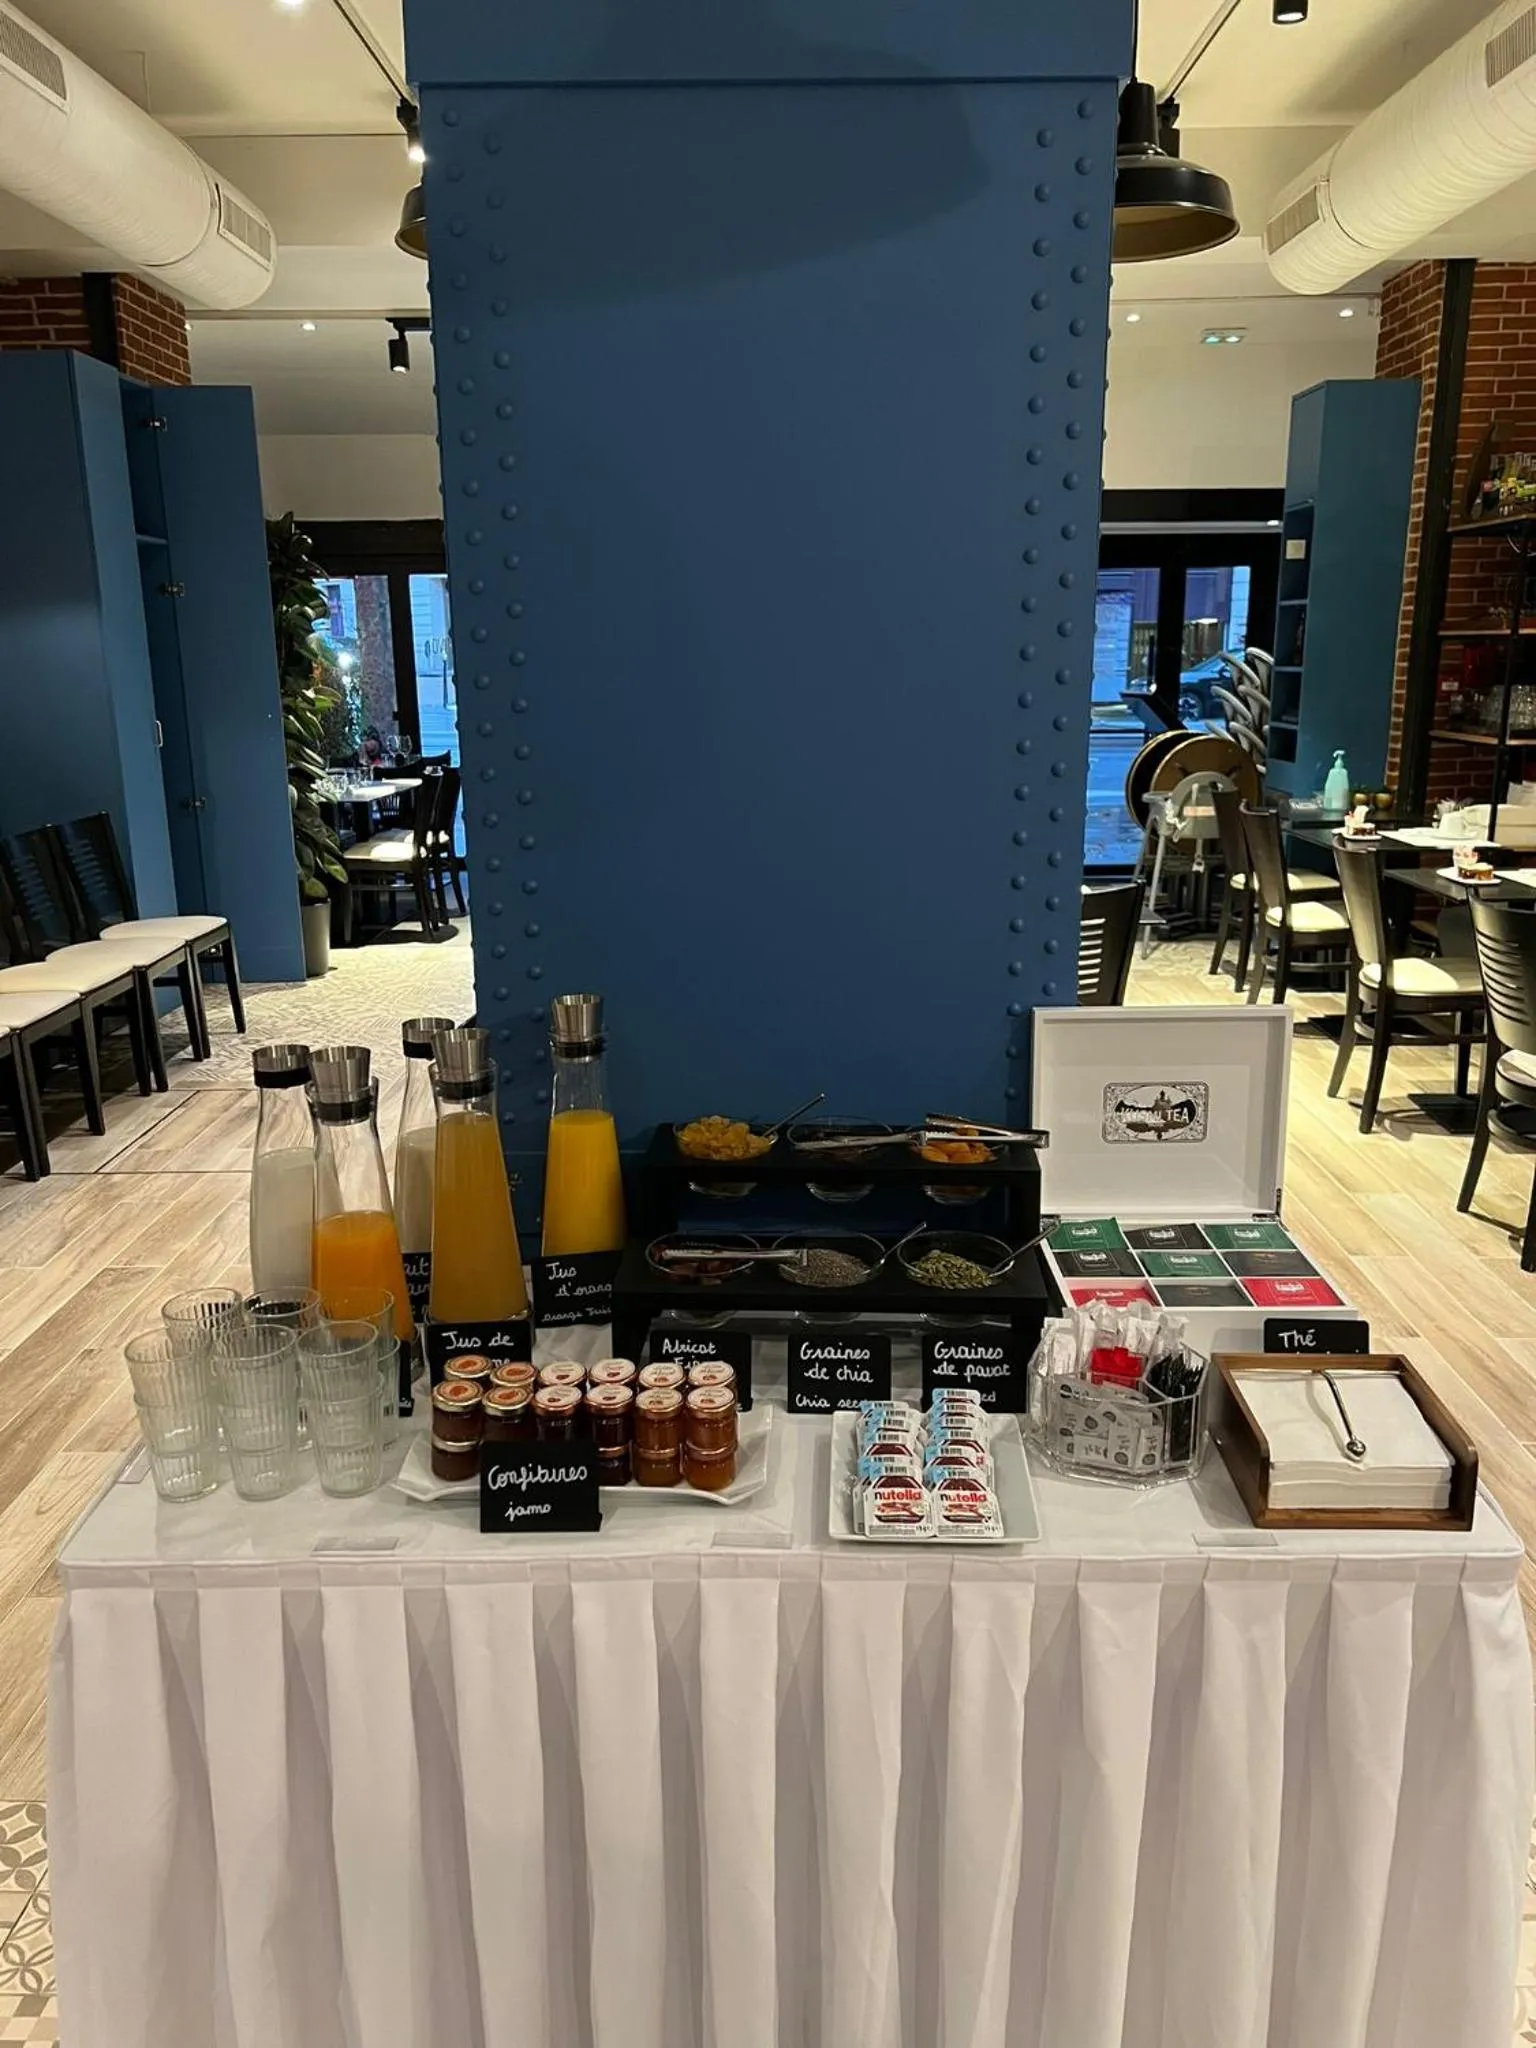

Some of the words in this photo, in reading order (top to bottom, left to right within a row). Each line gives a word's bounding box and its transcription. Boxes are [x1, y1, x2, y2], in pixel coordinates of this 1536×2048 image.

[1165, 1107, 1190, 1124] TEA
[545, 1262, 577, 1281] Jus
[442, 1331, 482, 1350] Jus
[488, 1332, 515, 1348] de
[1278, 1329, 1317, 1349] Thé
[800, 1341, 871, 1361] Graines
[934, 1341, 1004, 1360] Graines
[804, 1363, 830, 1380] de
[836, 1364, 874, 1383] chia
[932, 1361, 958, 1377] de
[963, 1363, 1011, 1384] pavot
[795, 1393, 830, 1409] Chia
[487, 1463, 588, 1492] Confitures
[874, 1489, 922, 1501] nutella
[940, 1493, 987, 1503] nutella
[504, 1501, 552, 1522] jams
